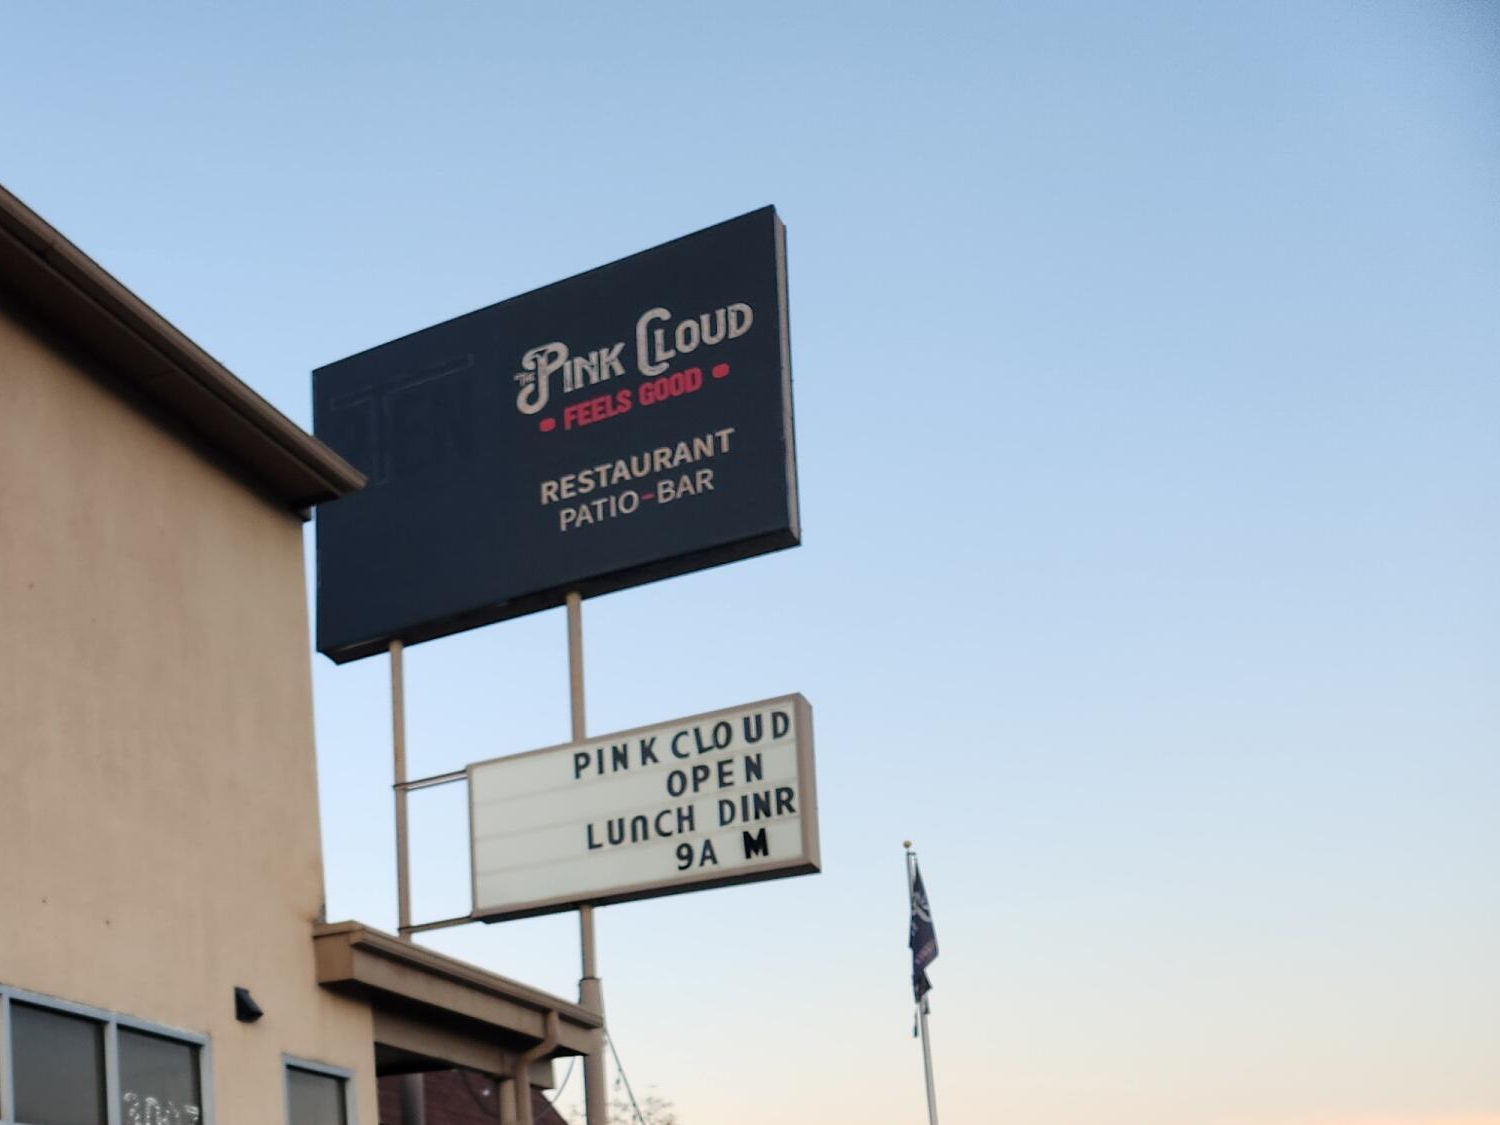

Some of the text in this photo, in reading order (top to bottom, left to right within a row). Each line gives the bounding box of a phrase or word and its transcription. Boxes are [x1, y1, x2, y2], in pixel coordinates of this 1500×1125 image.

[516, 302, 754, 415] PINK CLOUD
[563, 367, 703, 431] FEELS GOOD
[540, 427, 735, 506] RESTAURANT
[666, 753, 764, 798] OPEN
[718, 786, 796, 827] DINR
